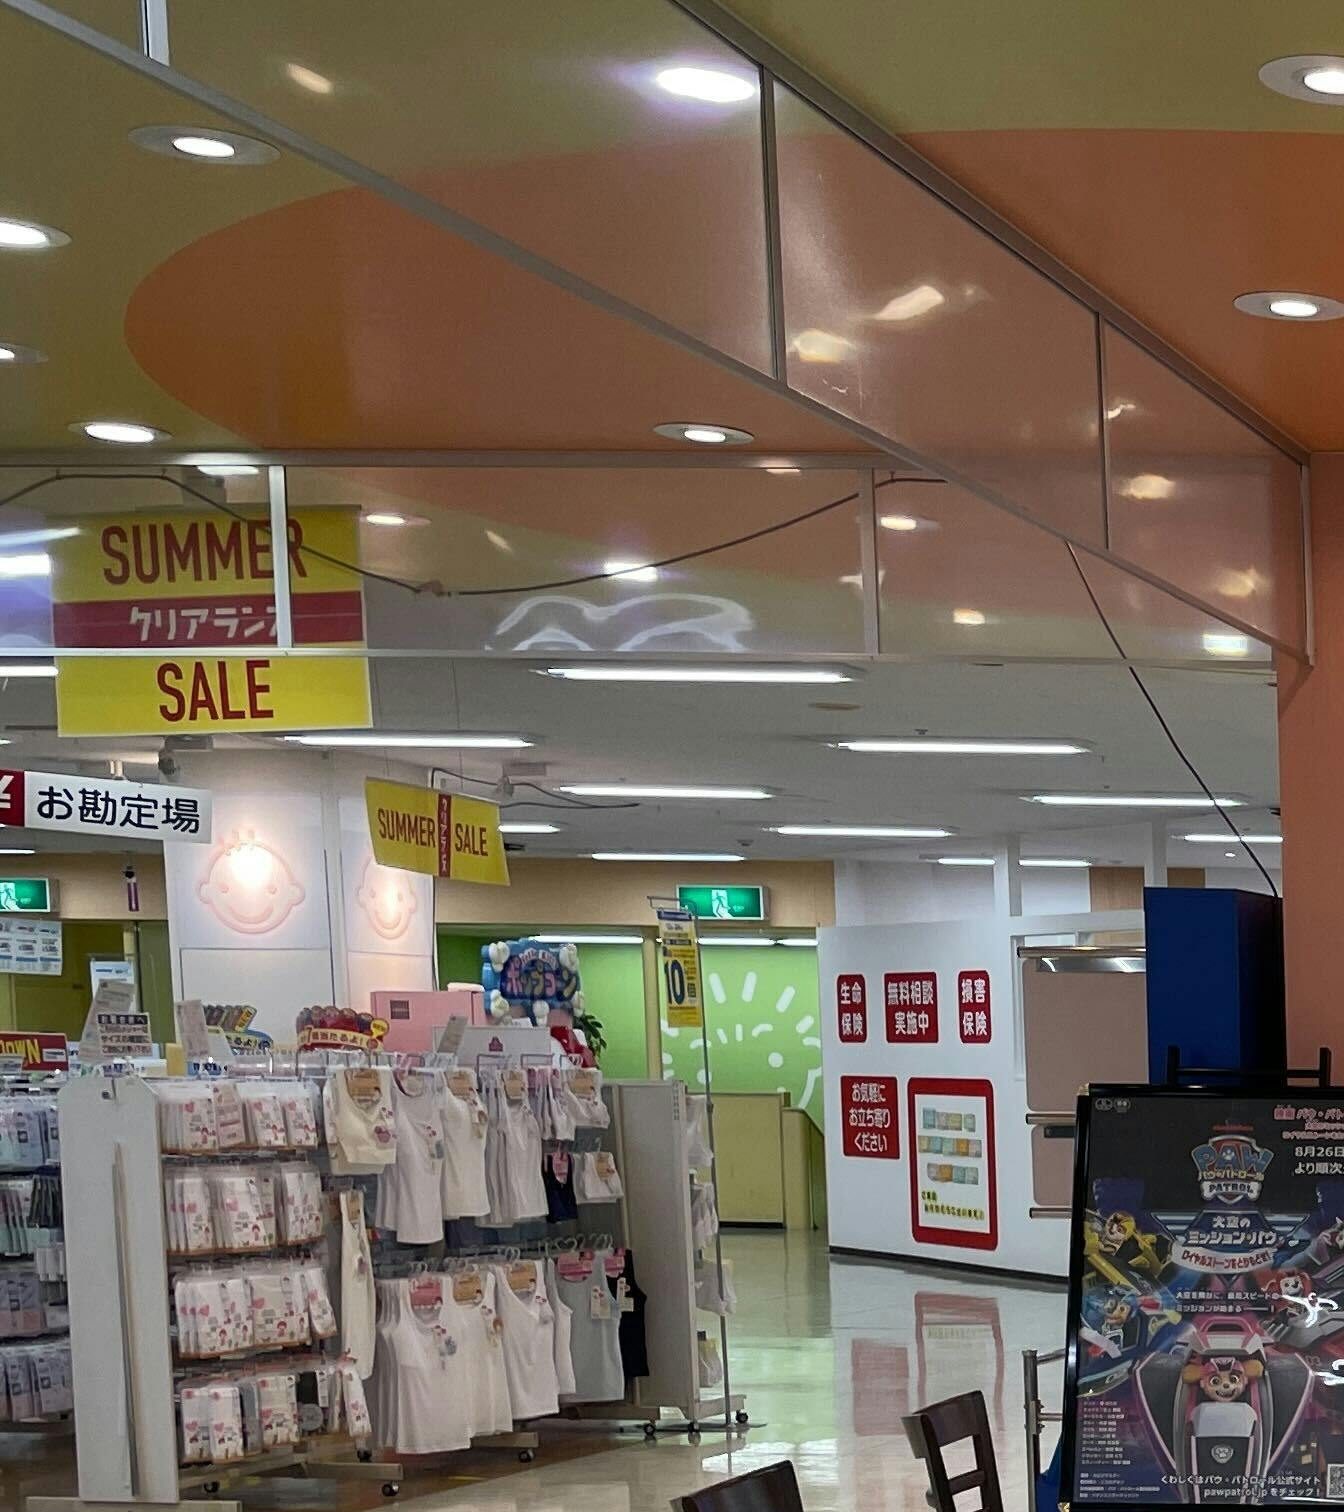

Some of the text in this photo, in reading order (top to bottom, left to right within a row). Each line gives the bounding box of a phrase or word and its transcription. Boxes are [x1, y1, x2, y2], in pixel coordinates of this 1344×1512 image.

[101, 518, 308, 586] SUMMER
[156, 658, 274, 722] SALE
[37, 785, 201, 834] お勘定場
[377, 807, 437, 849] SUMMER
[454, 822, 489, 857] SALE
[840, 981, 862, 1005] 生命
[887, 980, 934, 1006] 無料相談
[841, 1012, 864, 1036] 保険
[894, 1010, 929, 1036] 実施中
[962, 1010, 988, 1037] 保険
[851, 1082, 887, 1103] お気軽に
[849, 1108, 892, 1129] お立ち寄り
[853, 1132, 888, 1153] ください
